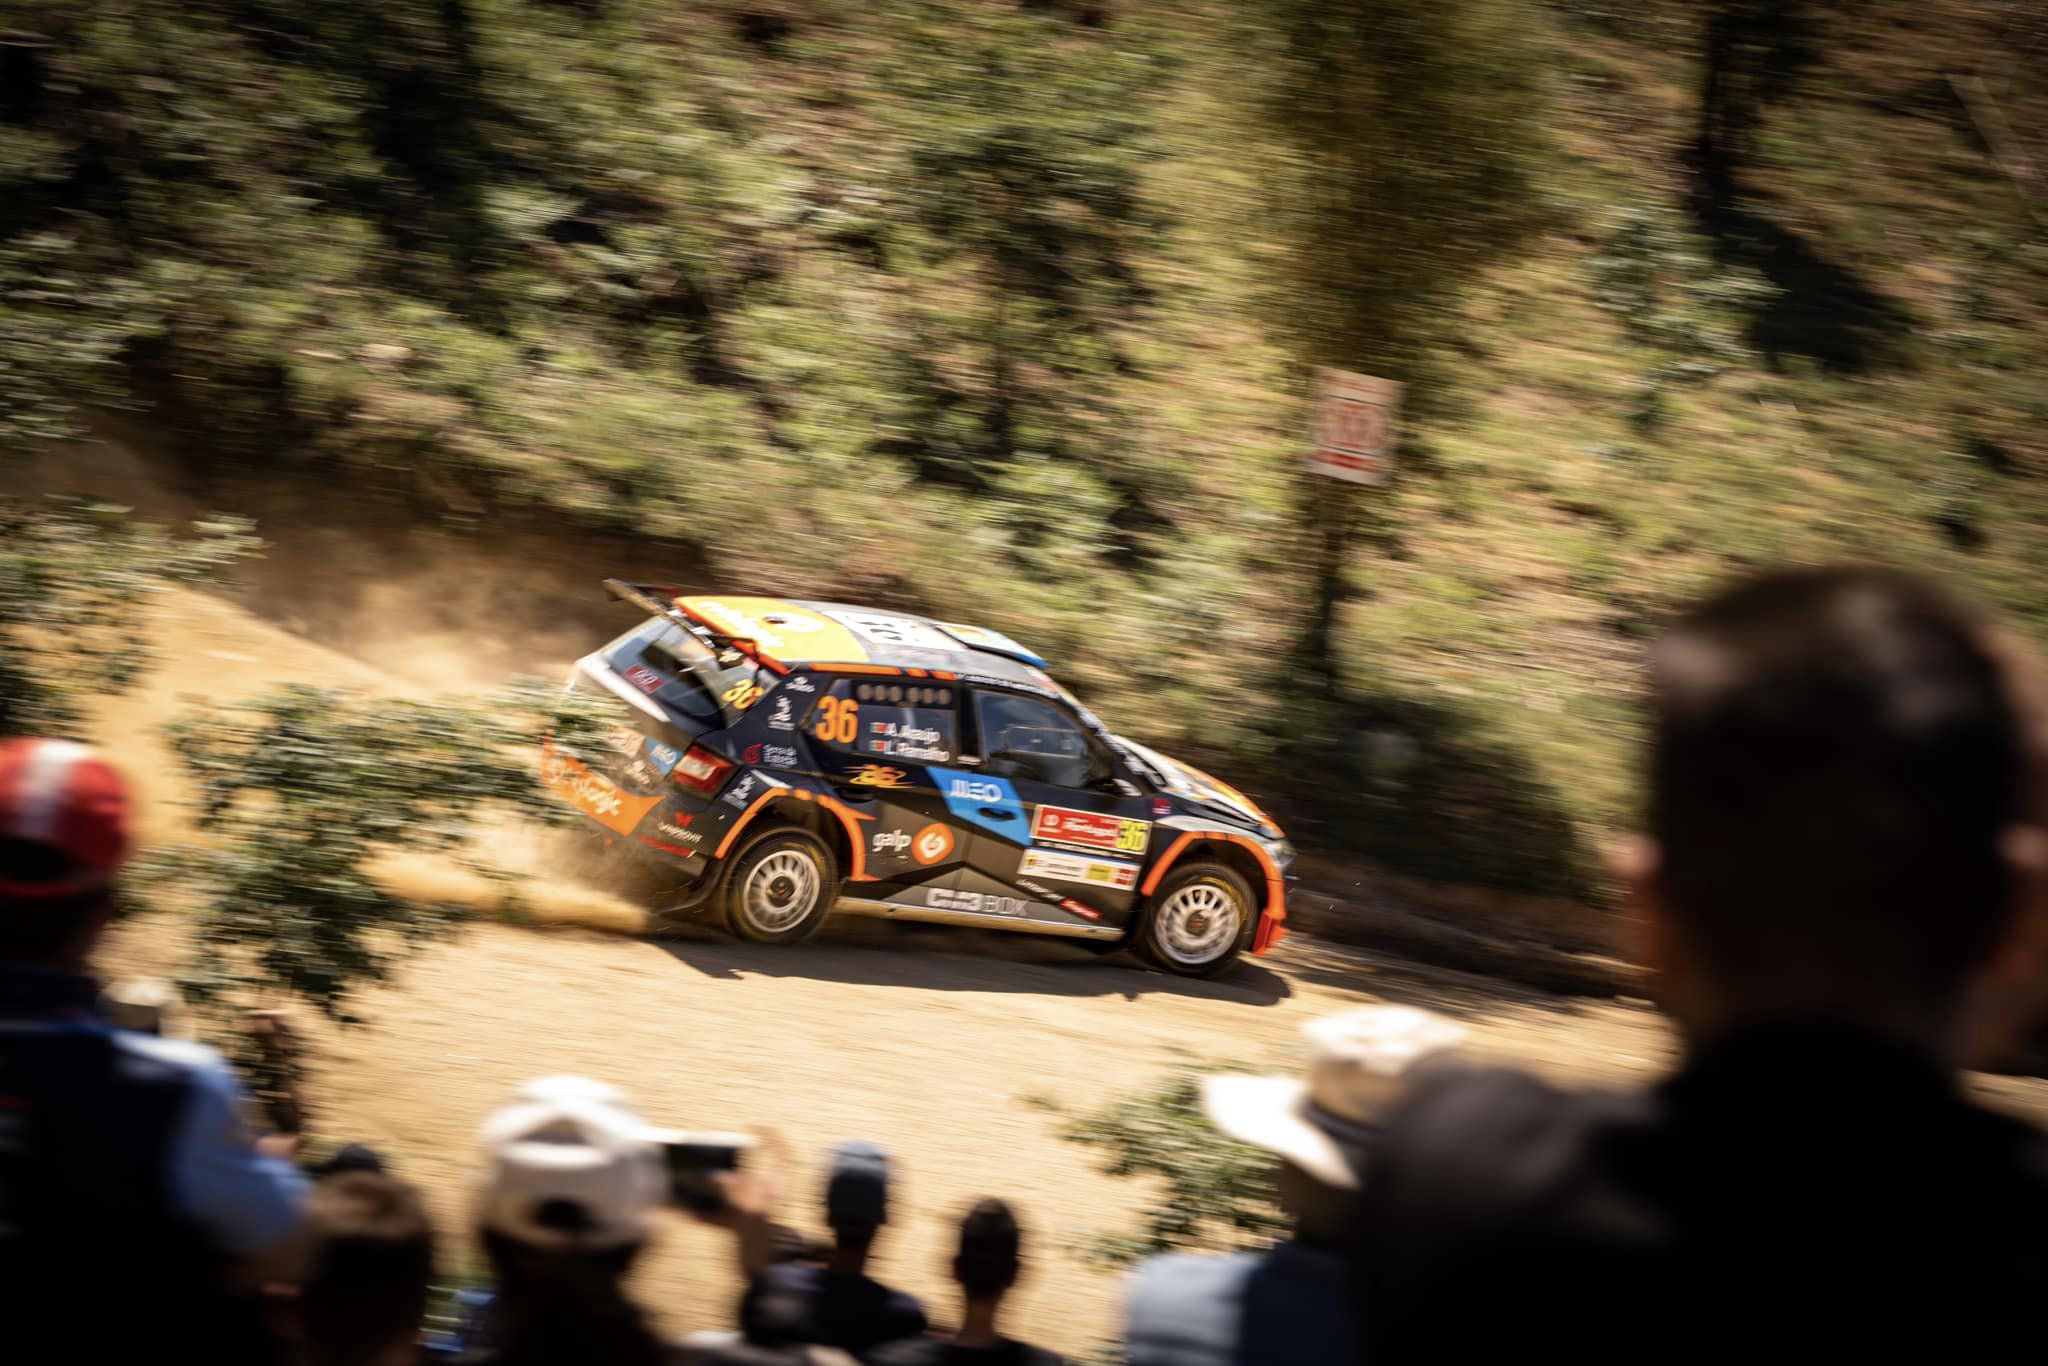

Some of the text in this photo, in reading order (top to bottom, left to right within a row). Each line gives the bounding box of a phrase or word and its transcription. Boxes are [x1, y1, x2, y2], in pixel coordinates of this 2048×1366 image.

[815, 695, 859, 743] 36
[872, 829, 912, 852] galp
[1115, 819, 1150, 852] 36
